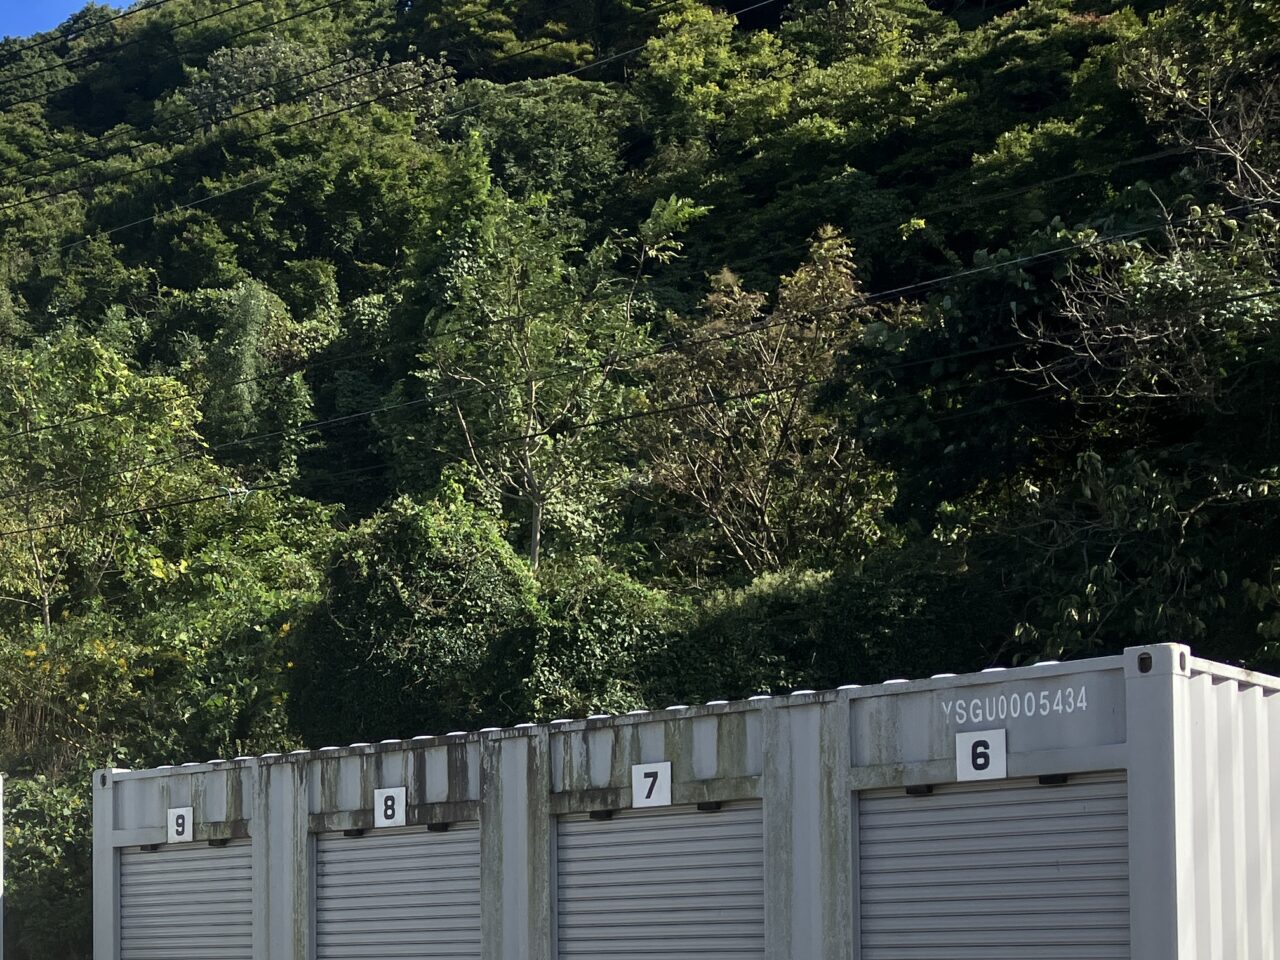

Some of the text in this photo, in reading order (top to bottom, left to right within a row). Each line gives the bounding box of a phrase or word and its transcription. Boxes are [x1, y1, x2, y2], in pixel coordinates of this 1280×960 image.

[942, 686, 1088, 724] YSGU0005434
[971, 740, 991, 771] 6
[643, 771, 659, 799] 7
[383, 795, 396, 820] 8
[175, 814, 186, 837] 9
